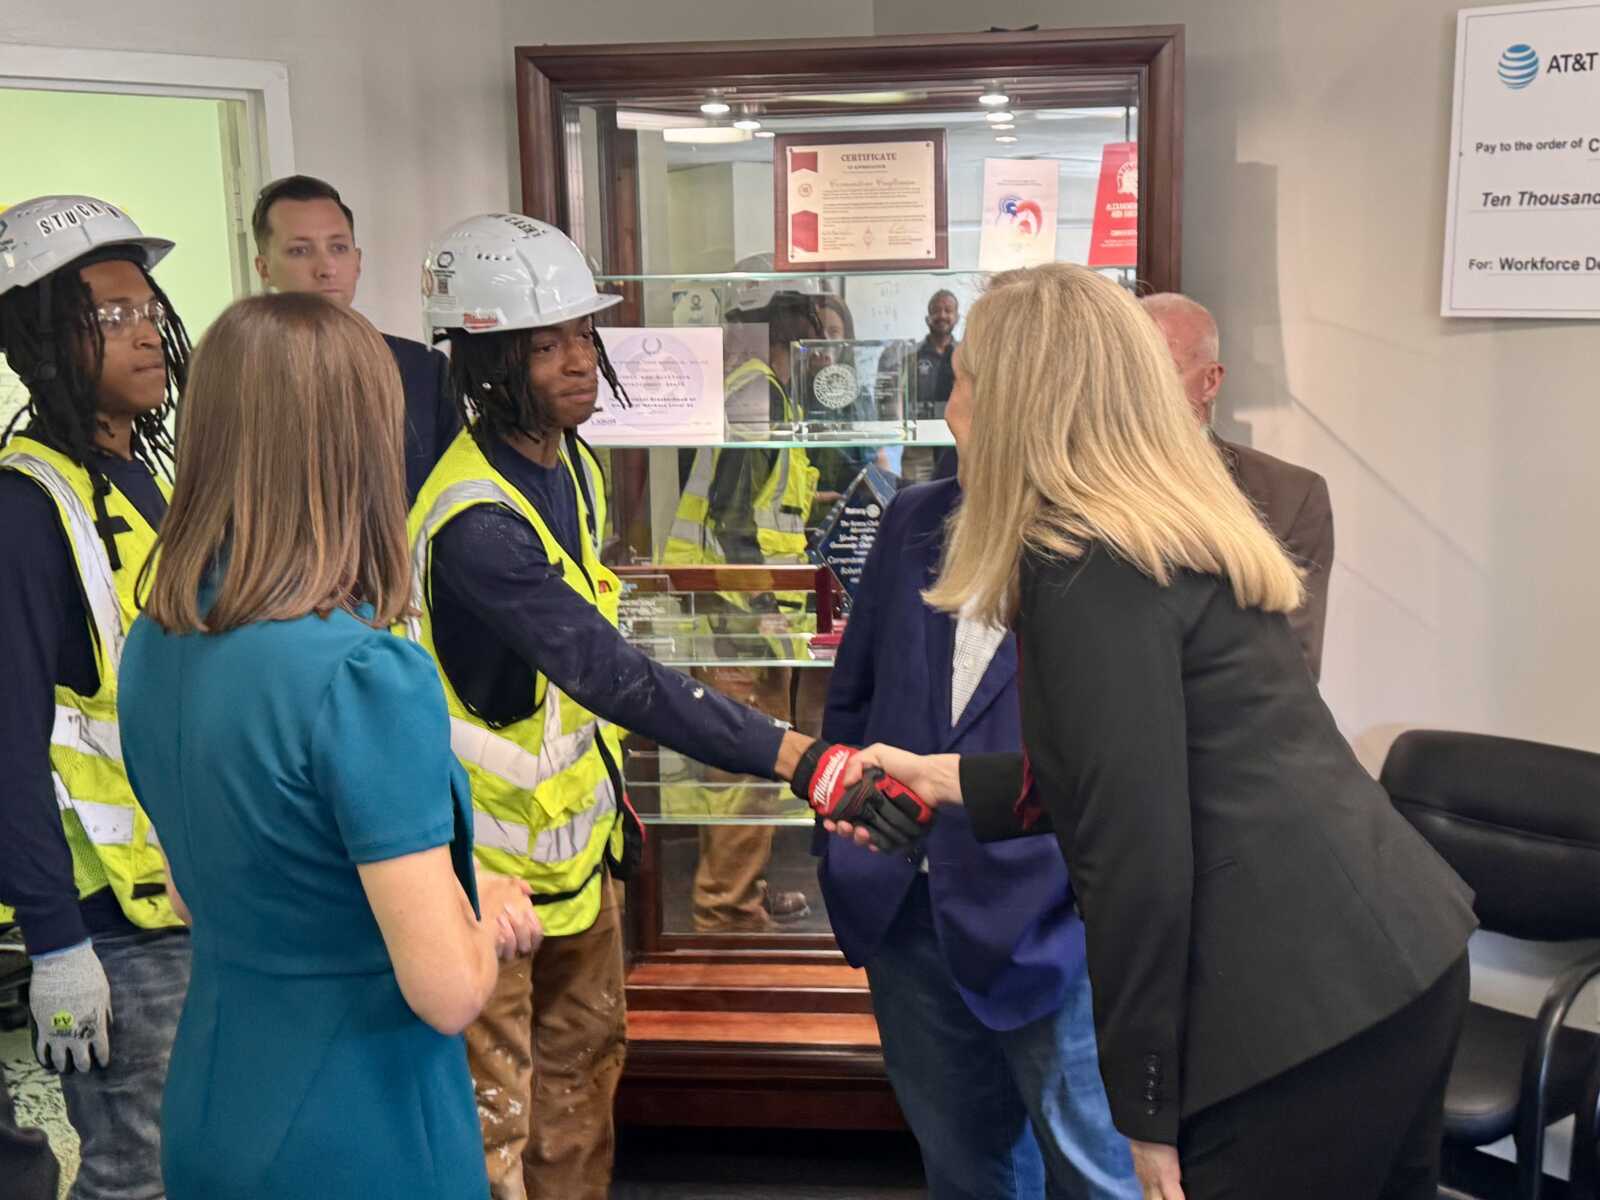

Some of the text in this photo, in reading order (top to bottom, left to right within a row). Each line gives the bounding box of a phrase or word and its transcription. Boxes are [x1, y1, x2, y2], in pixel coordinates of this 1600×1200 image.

[1546, 52, 1599, 74] AT&T
[1475, 141, 1497, 155] Pay
[1499, 141, 1512, 152] to
[1514, 139, 1533, 151] the
[1535, 137, 1567, 150] order
[1570, 137, 1583, 149] of
[840, 152, 897, 162] CERTIFICATE
[1482, 191, 1512, 207] Ten
[1468, 258, 1493, 271] For:
[1499, 256, 1580, 272] Workforce
